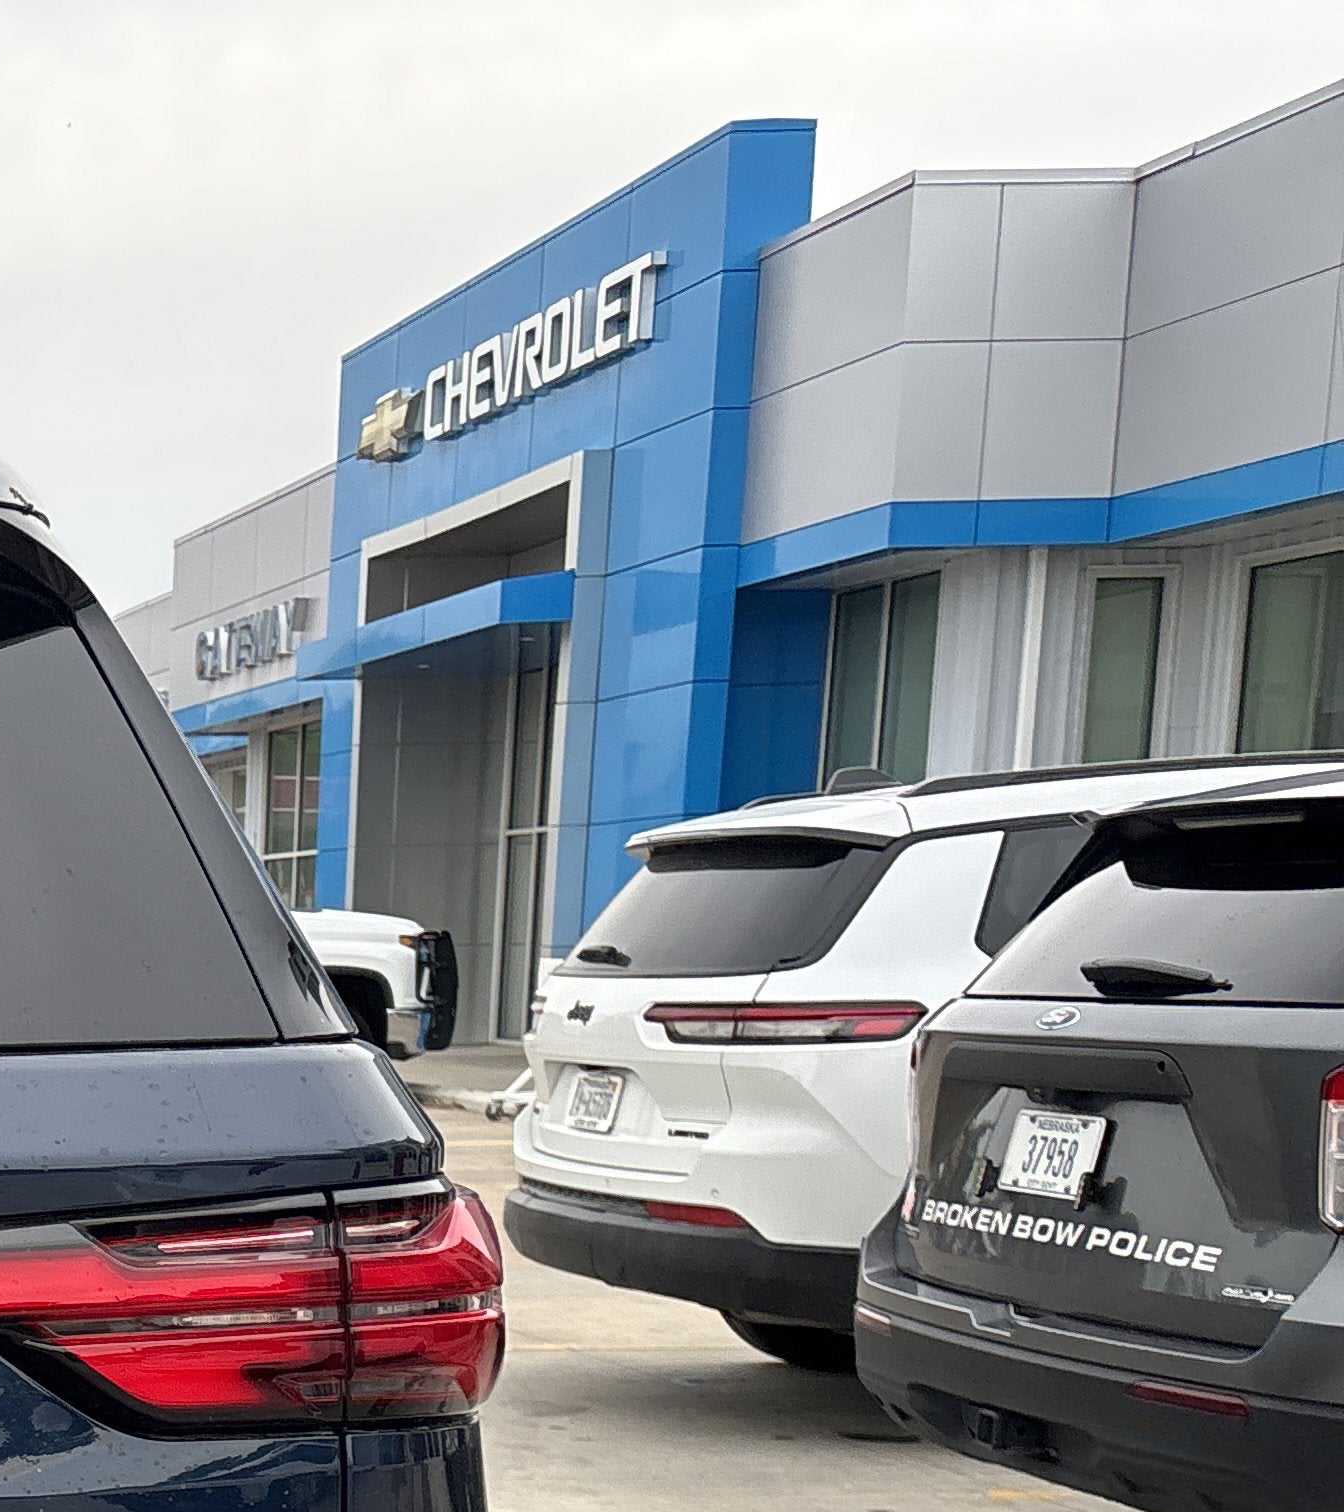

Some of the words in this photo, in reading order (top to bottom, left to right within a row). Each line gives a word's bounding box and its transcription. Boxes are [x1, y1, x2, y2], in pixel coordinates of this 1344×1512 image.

[423, 250, 668, 441] CHEVROLET
[1021, 1134, 1079, 1179] 37958
[922, 1199, 1012, 1236] BROKEN
[1012, 1214, 1085, 1247] BOW
[1085, 1226, 1223, 1272] POLICE
